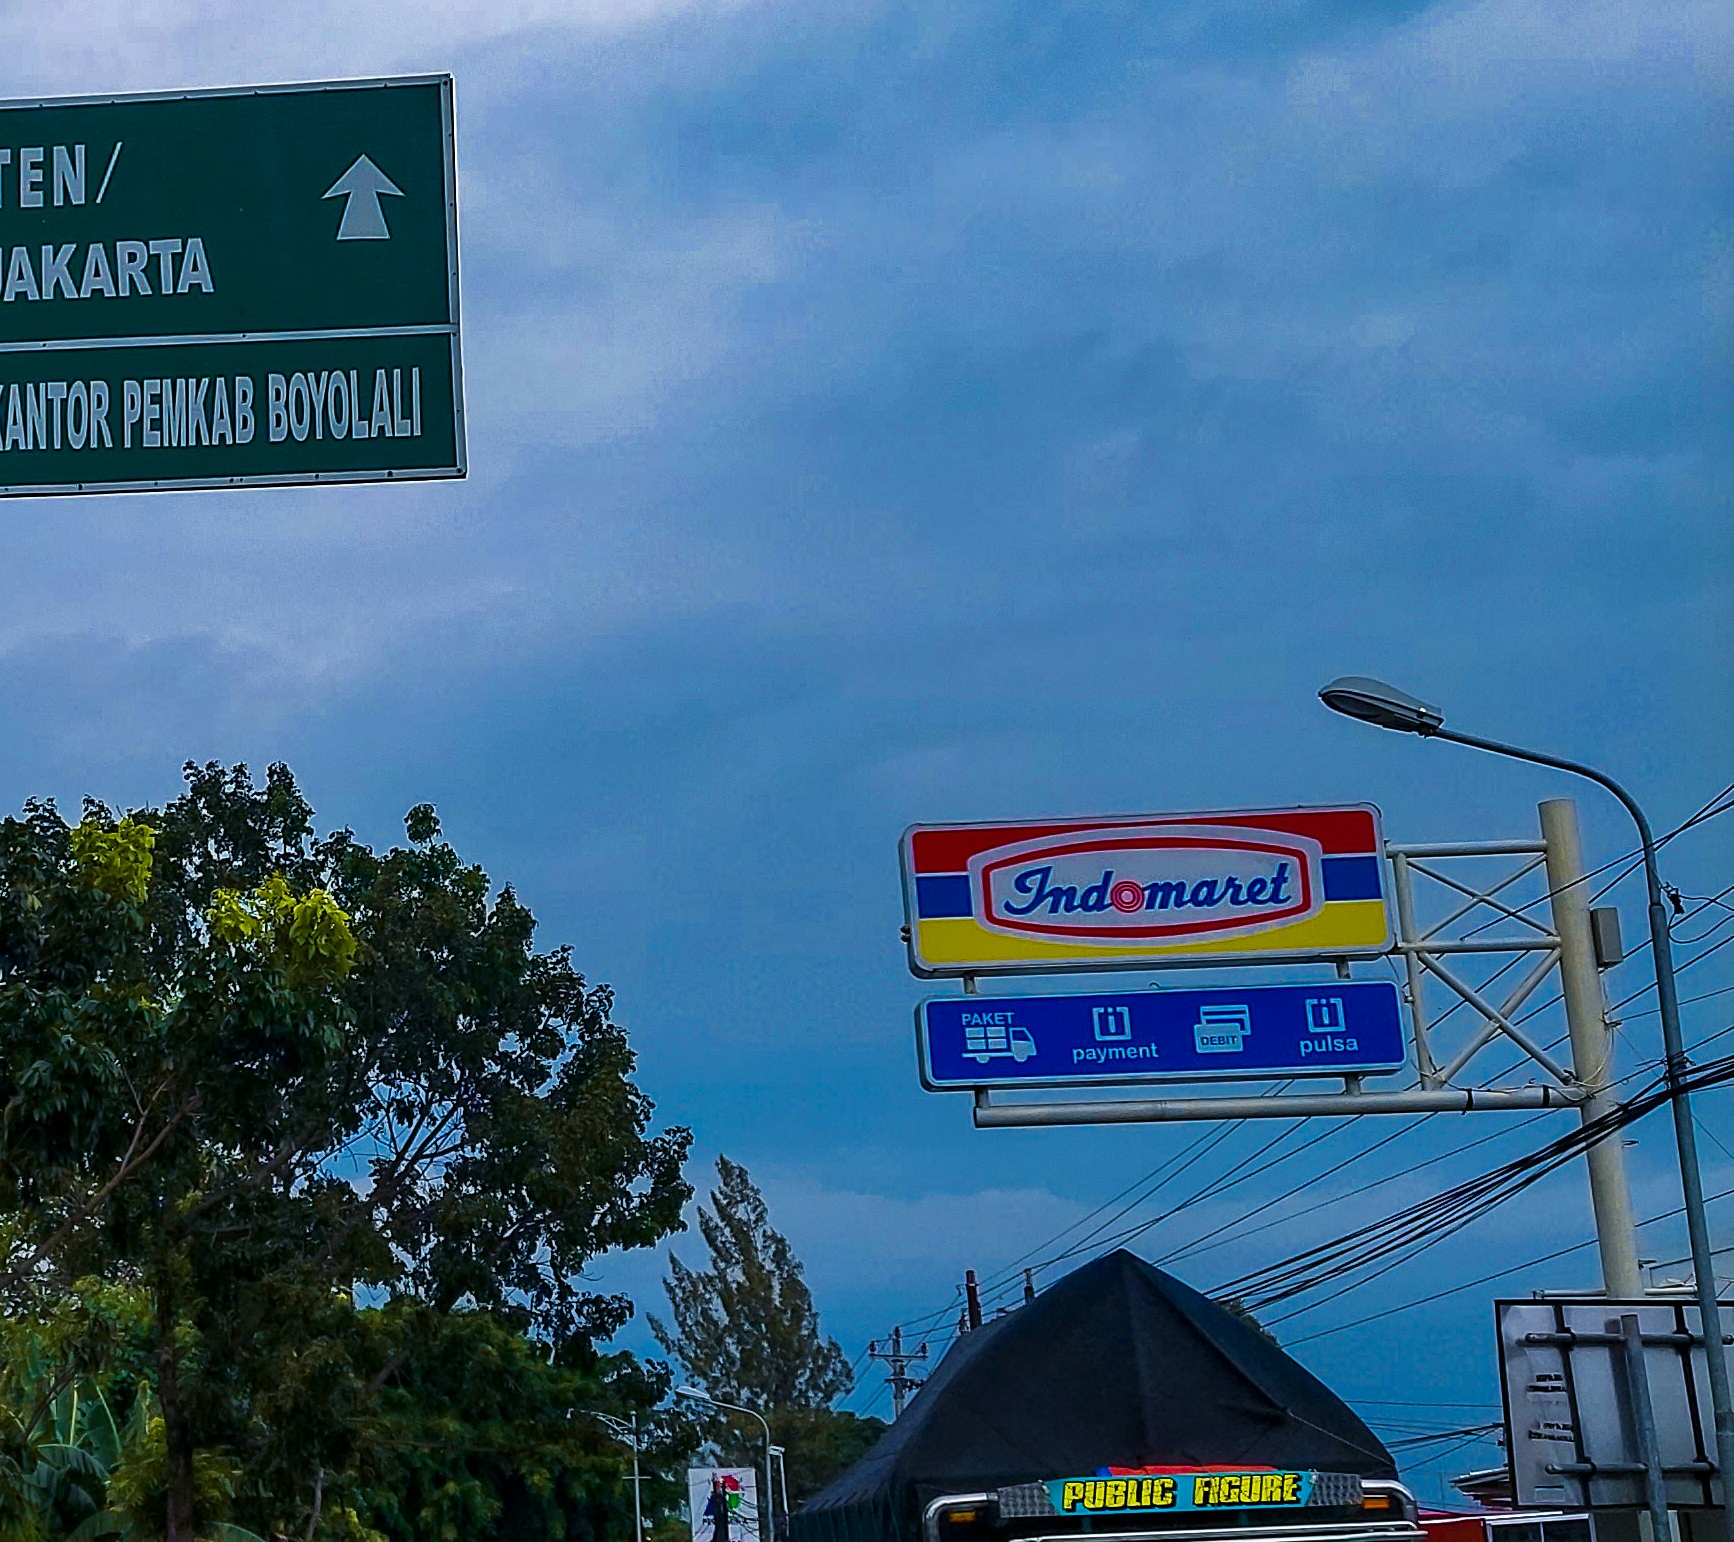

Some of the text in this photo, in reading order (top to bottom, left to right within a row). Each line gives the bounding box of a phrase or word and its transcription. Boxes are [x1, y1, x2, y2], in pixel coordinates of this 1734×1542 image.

[124, 376, 255, 449] PEMKAB
[268, 367, 422, 443] BOYOLALI
[1003, 863, 1293, 916] Indomaret
[961, 1012, 1015, 1026] PAKET
[1072, 1041, 1159, 1064] payment
[1200, 1033, 1239, 1047] DEBIT
[1299, 1033, 1359, 1058] pulsa
[1063, 1473, 1302, 1511] PUBLIC FIGURE
